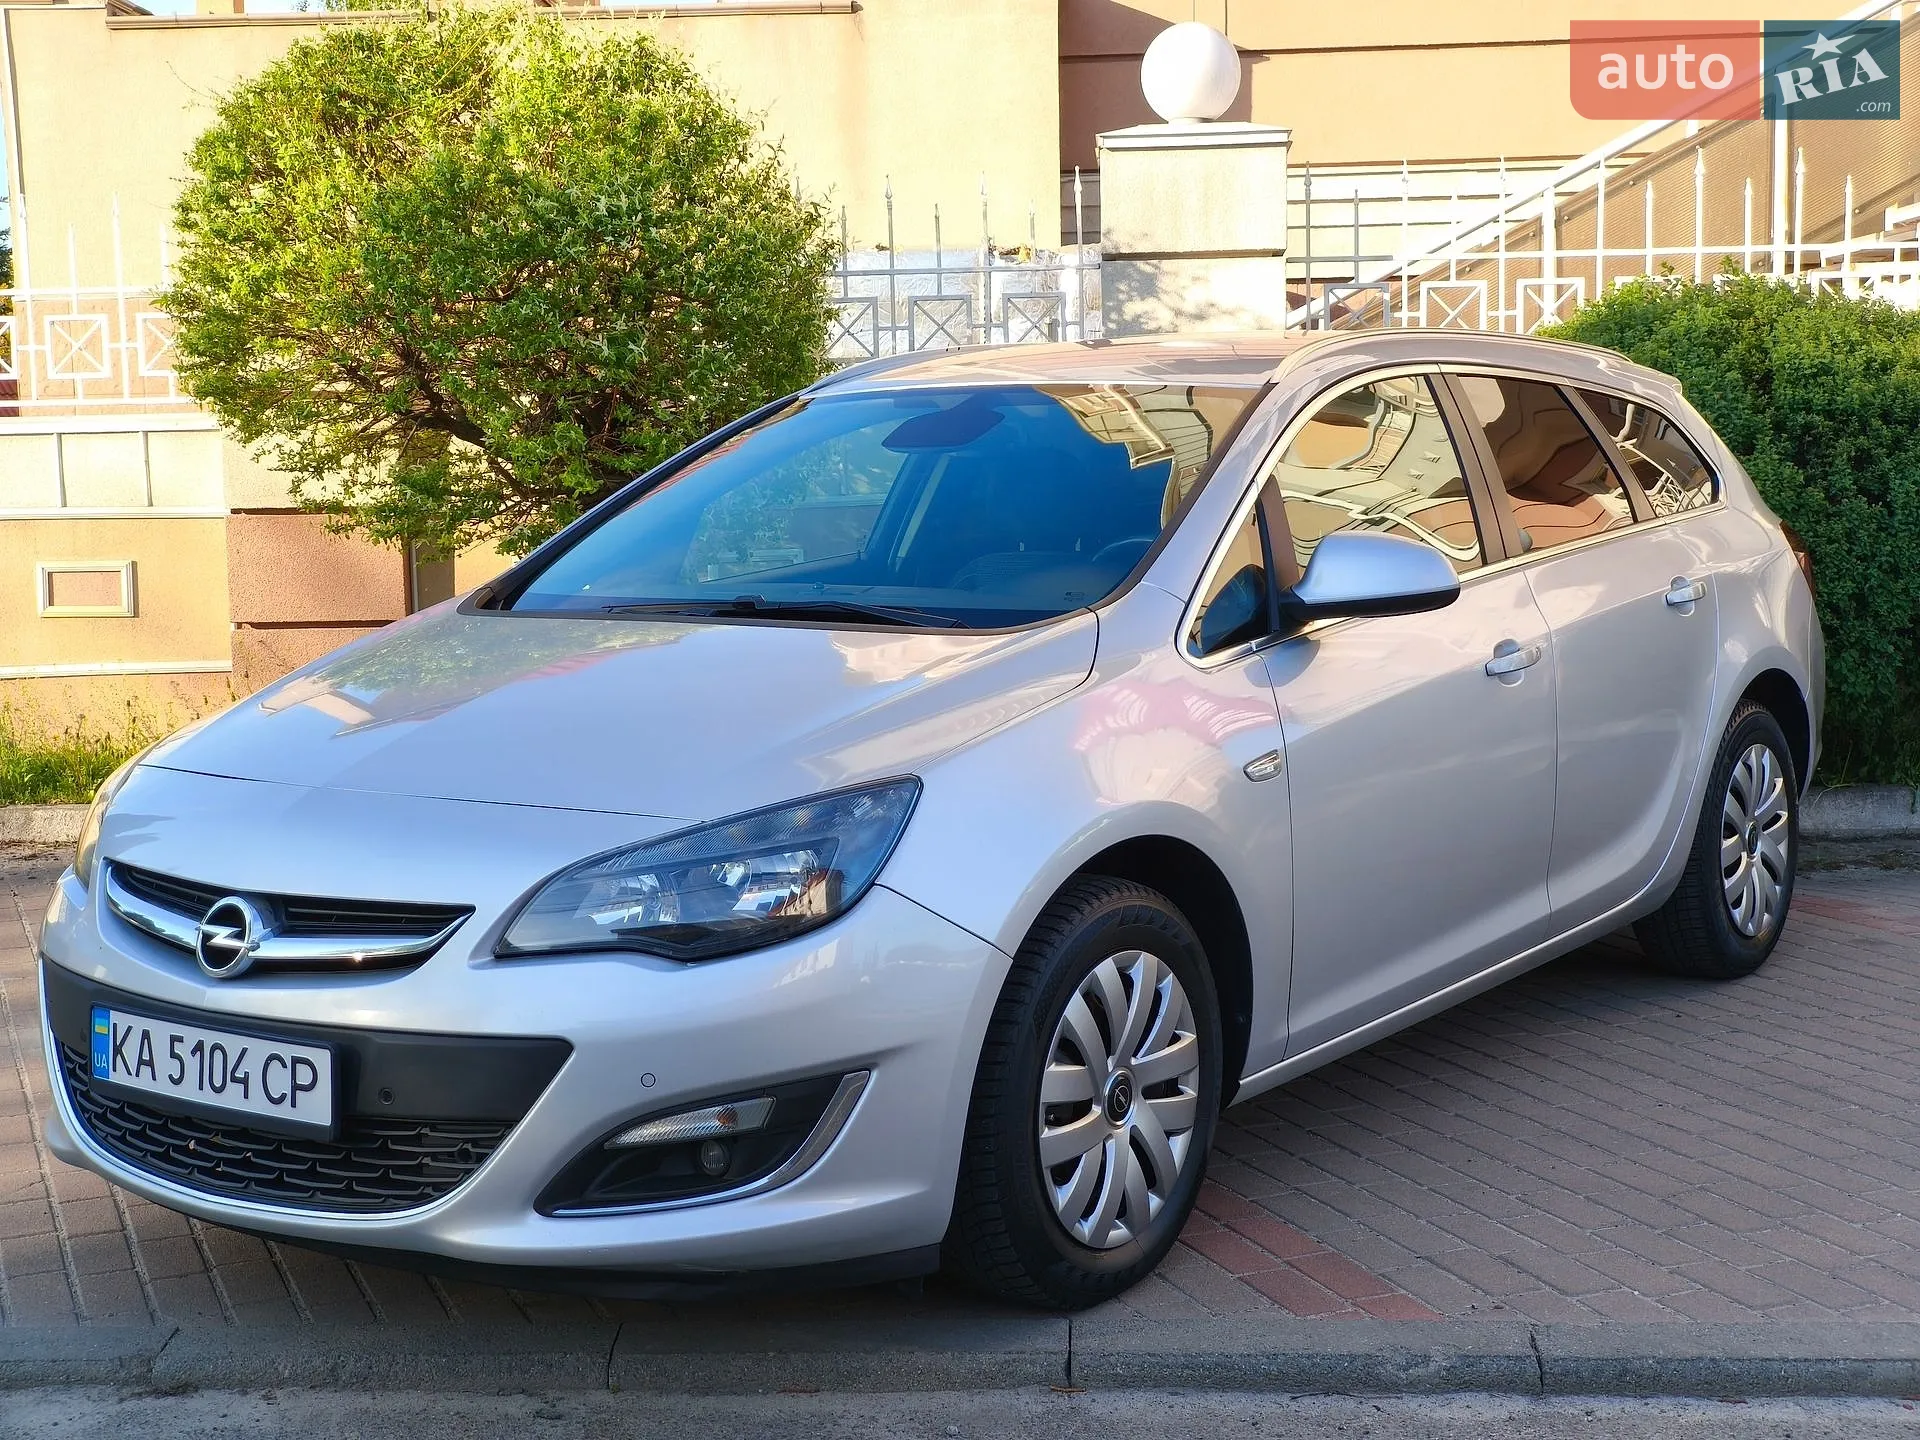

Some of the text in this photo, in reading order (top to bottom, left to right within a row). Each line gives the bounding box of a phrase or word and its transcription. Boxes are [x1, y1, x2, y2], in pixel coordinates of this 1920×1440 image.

[94, 1052, 108, 1070] UA
[112, 1022, 319, 1108] KA 5104 CP
